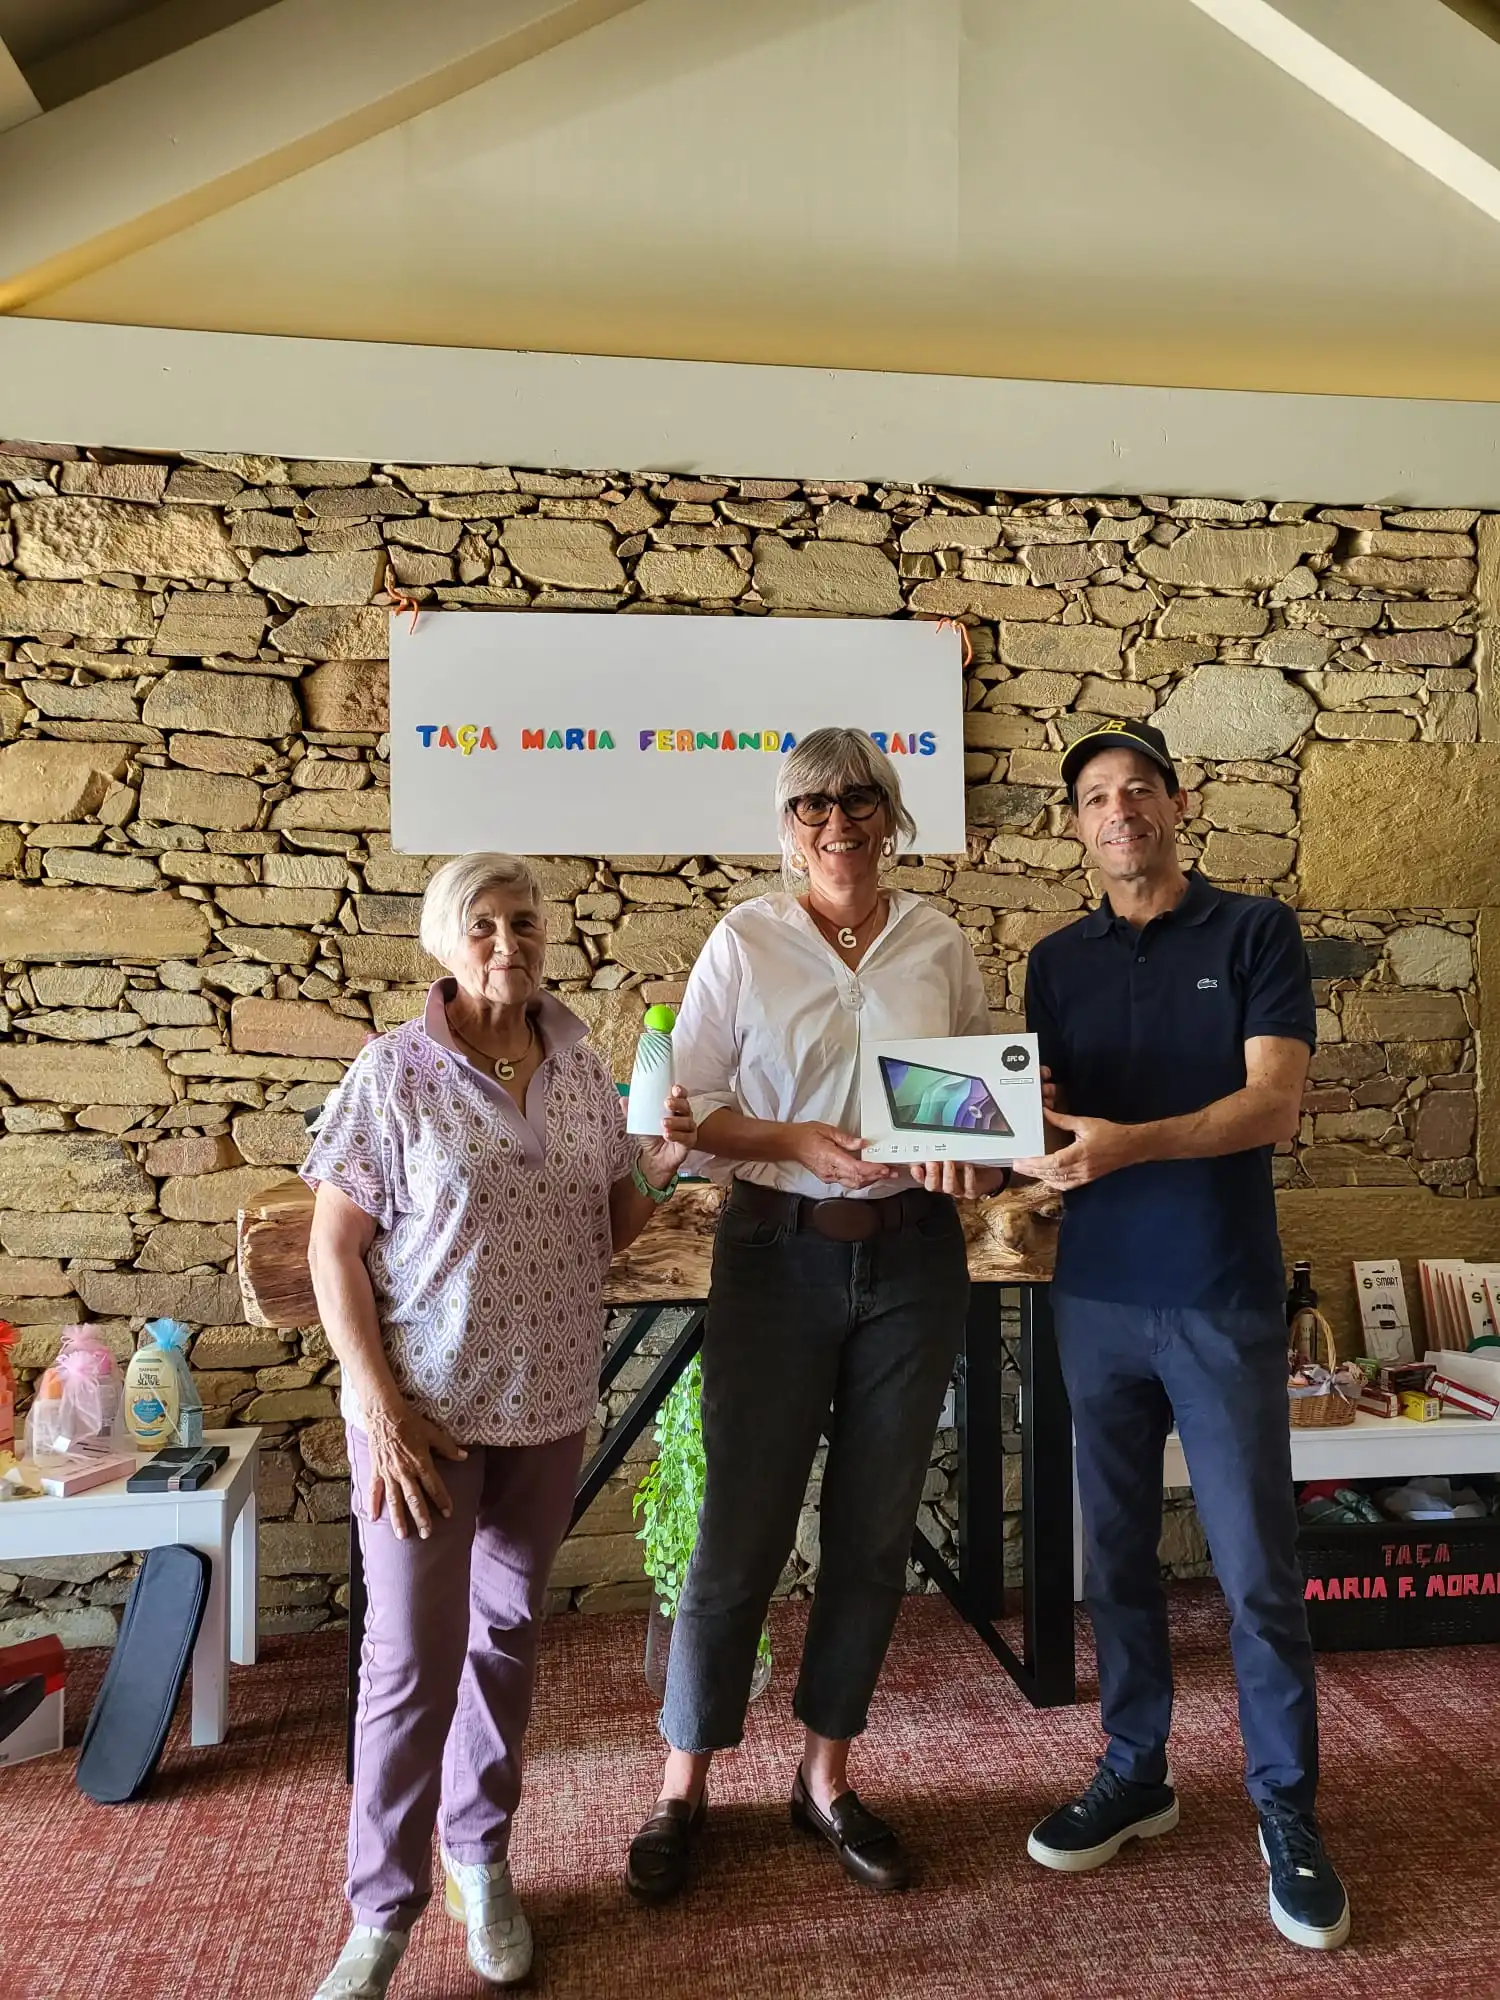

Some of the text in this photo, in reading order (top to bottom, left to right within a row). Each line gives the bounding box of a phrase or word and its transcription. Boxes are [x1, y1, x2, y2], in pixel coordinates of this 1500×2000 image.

[415, 724, 937, 756] TAÇA MARIA FERNANDA RAIS
[1375, 1276, 1399, 1288] SMART
[1382, 1544, 1451, 1568] TAÇA
[1304, 1577, 1388, 1601] MARIA
[1399, 1577, 1416, 1598] F.
